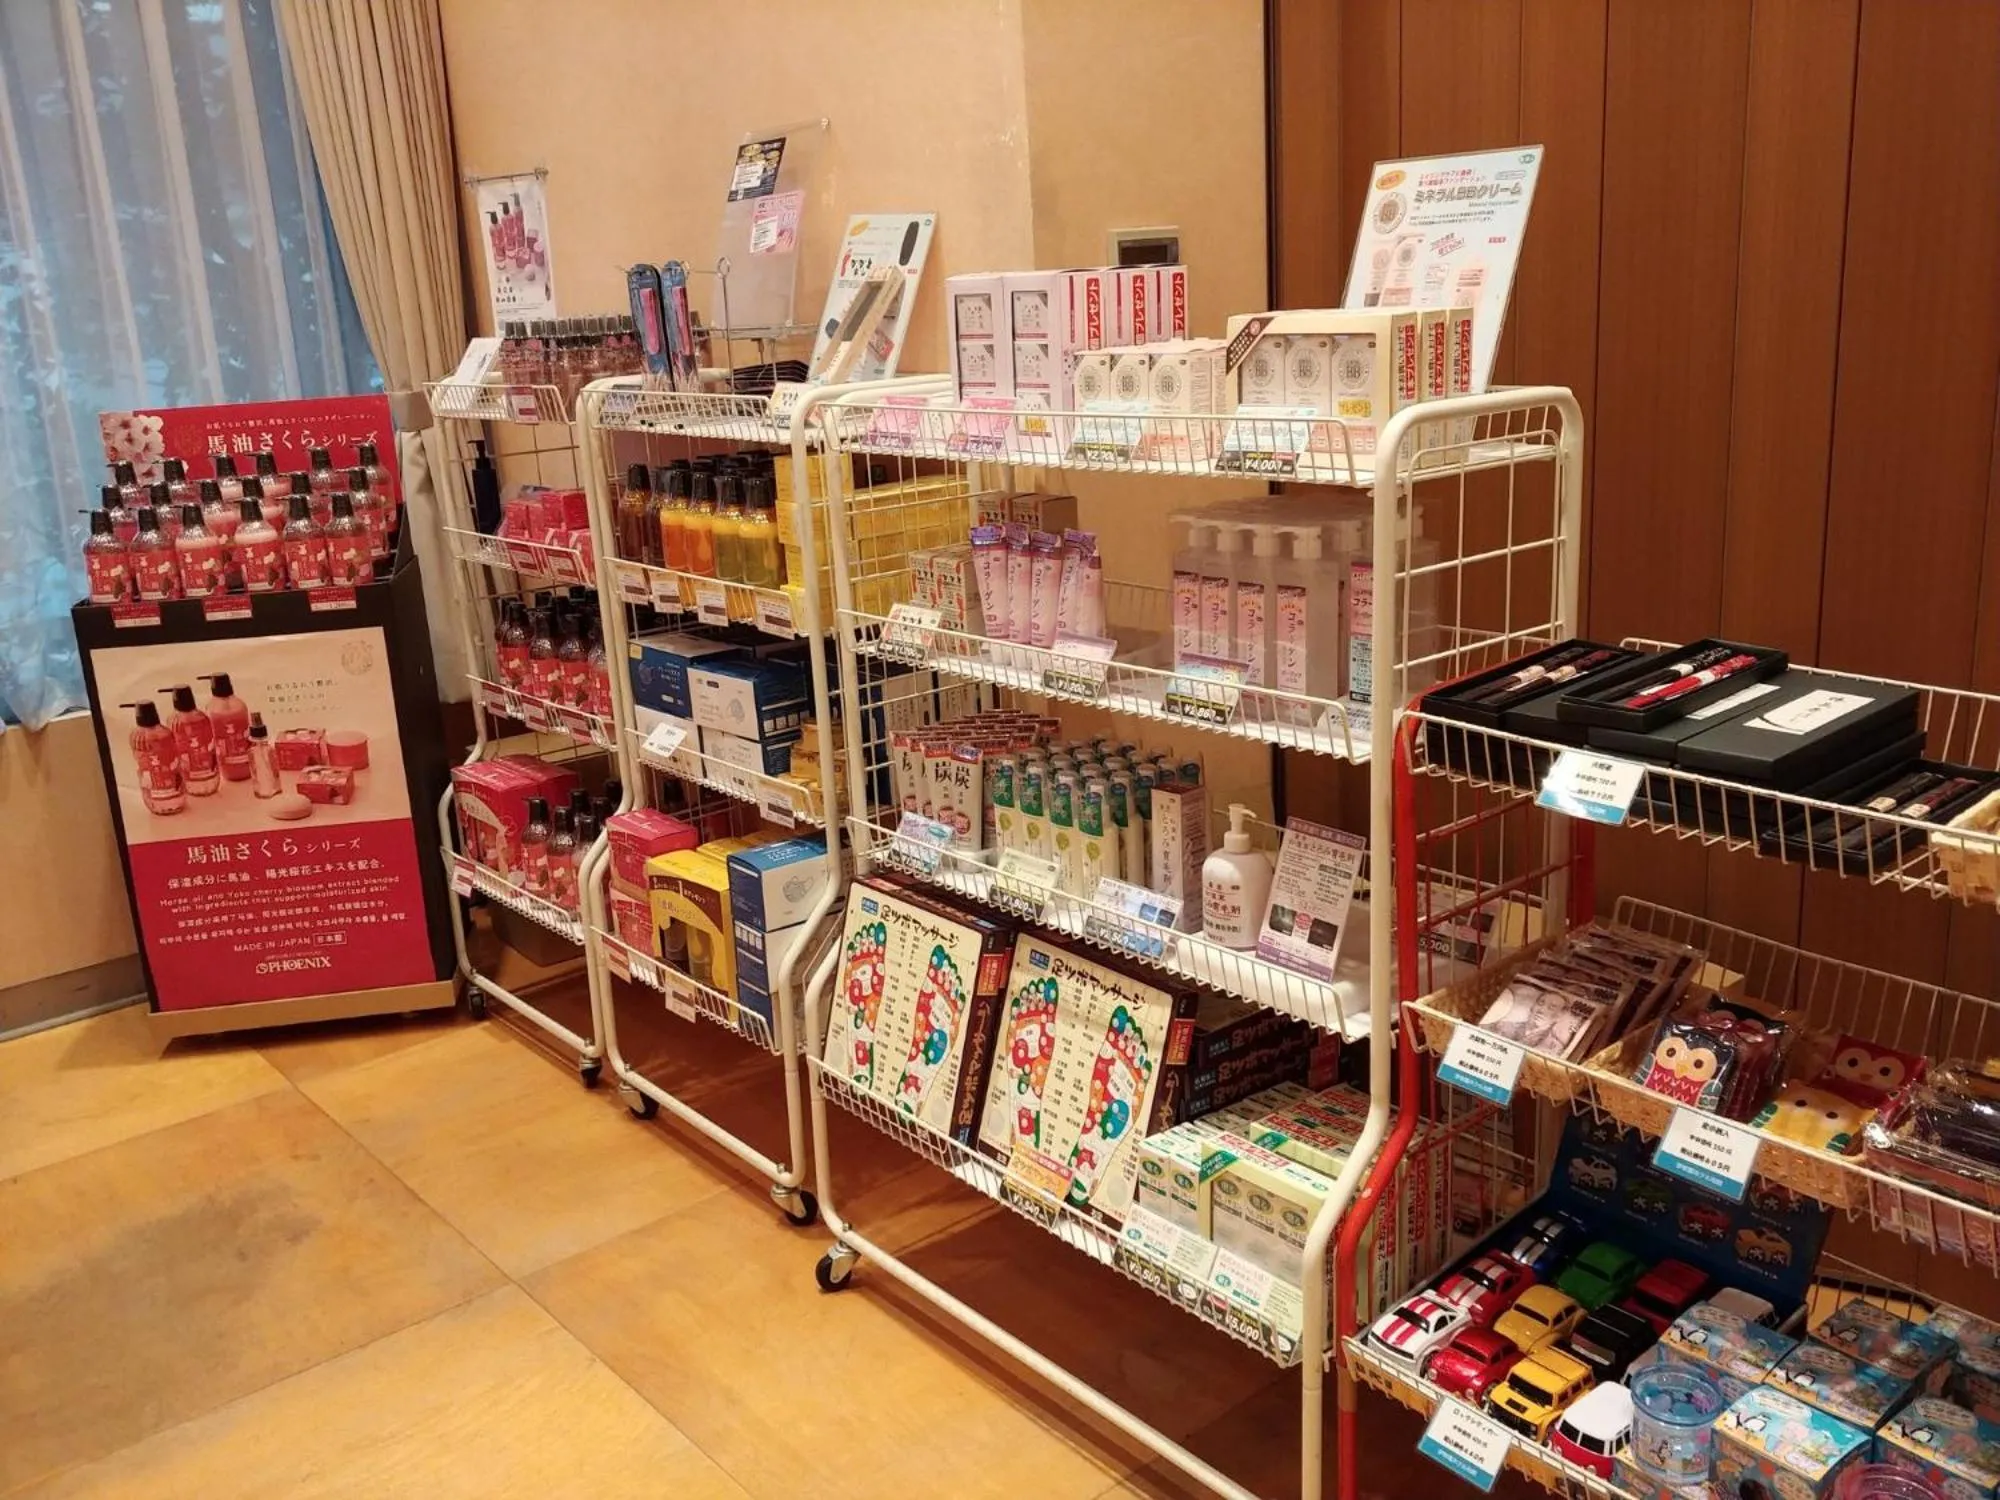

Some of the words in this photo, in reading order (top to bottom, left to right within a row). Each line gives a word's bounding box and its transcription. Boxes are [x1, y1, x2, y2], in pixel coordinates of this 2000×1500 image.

[171, 904, 191, 914] with
[195, 897, 248, 912] ingredients
[252, 895, 271, 903] that
[274, 890, 310, 902] support
[313, 885, 366, 898] moisturized
[253, 887, 283, 899] cherry
[286, 883, 325, 893] blossom
[327, 878, 361, 889] extract
[880, 904, 960, 949] 足ツボマッサージ
[233, 942, 262, 952] MADE
[265, 940, 276, 949] IN
[279, 936, 310, 947] JAPAN
[269, 956, 332, 972] PHOENIX
[1052, 957, 1146, 1010] 足ツボマッサージ
